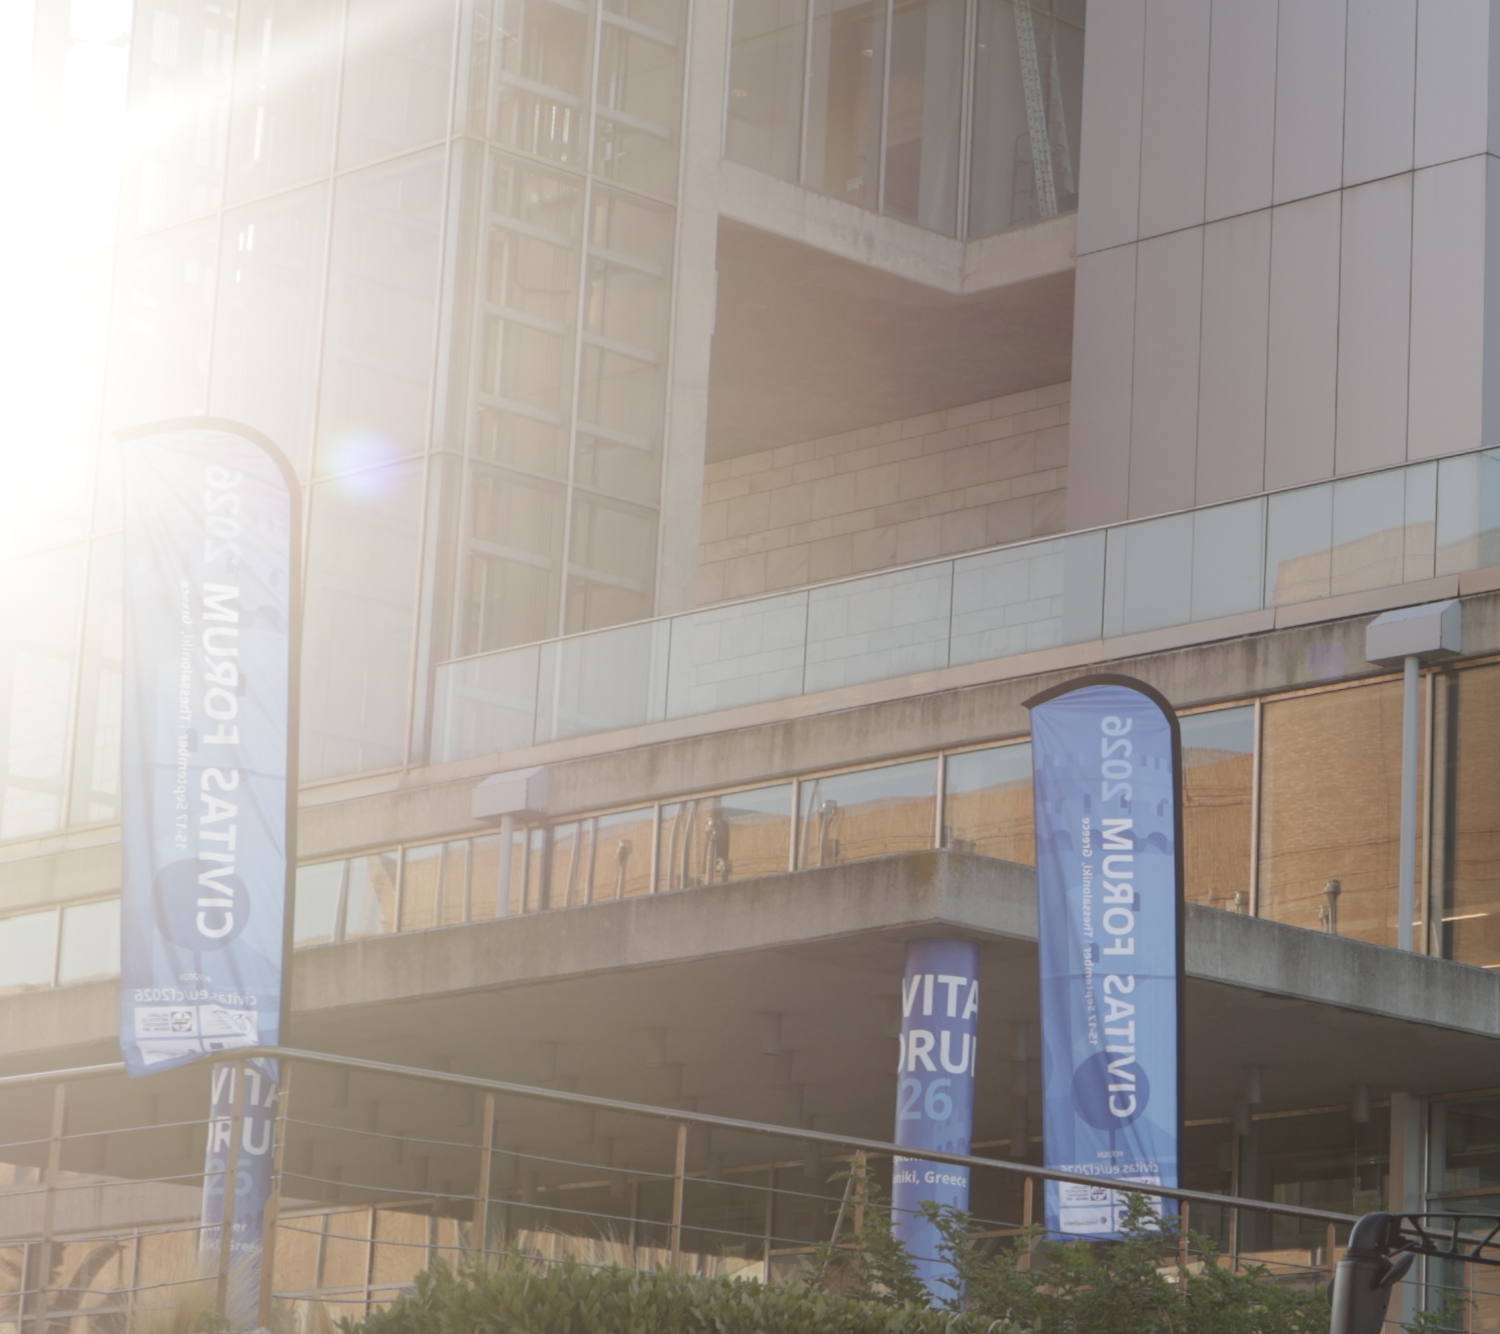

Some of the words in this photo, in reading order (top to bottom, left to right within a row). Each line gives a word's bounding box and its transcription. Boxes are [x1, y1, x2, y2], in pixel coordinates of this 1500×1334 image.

[897, 1029, 977, 1078] RU
[900, 1078, 953, 1121] 26
[924, 1170, 967, 1187] Greece
